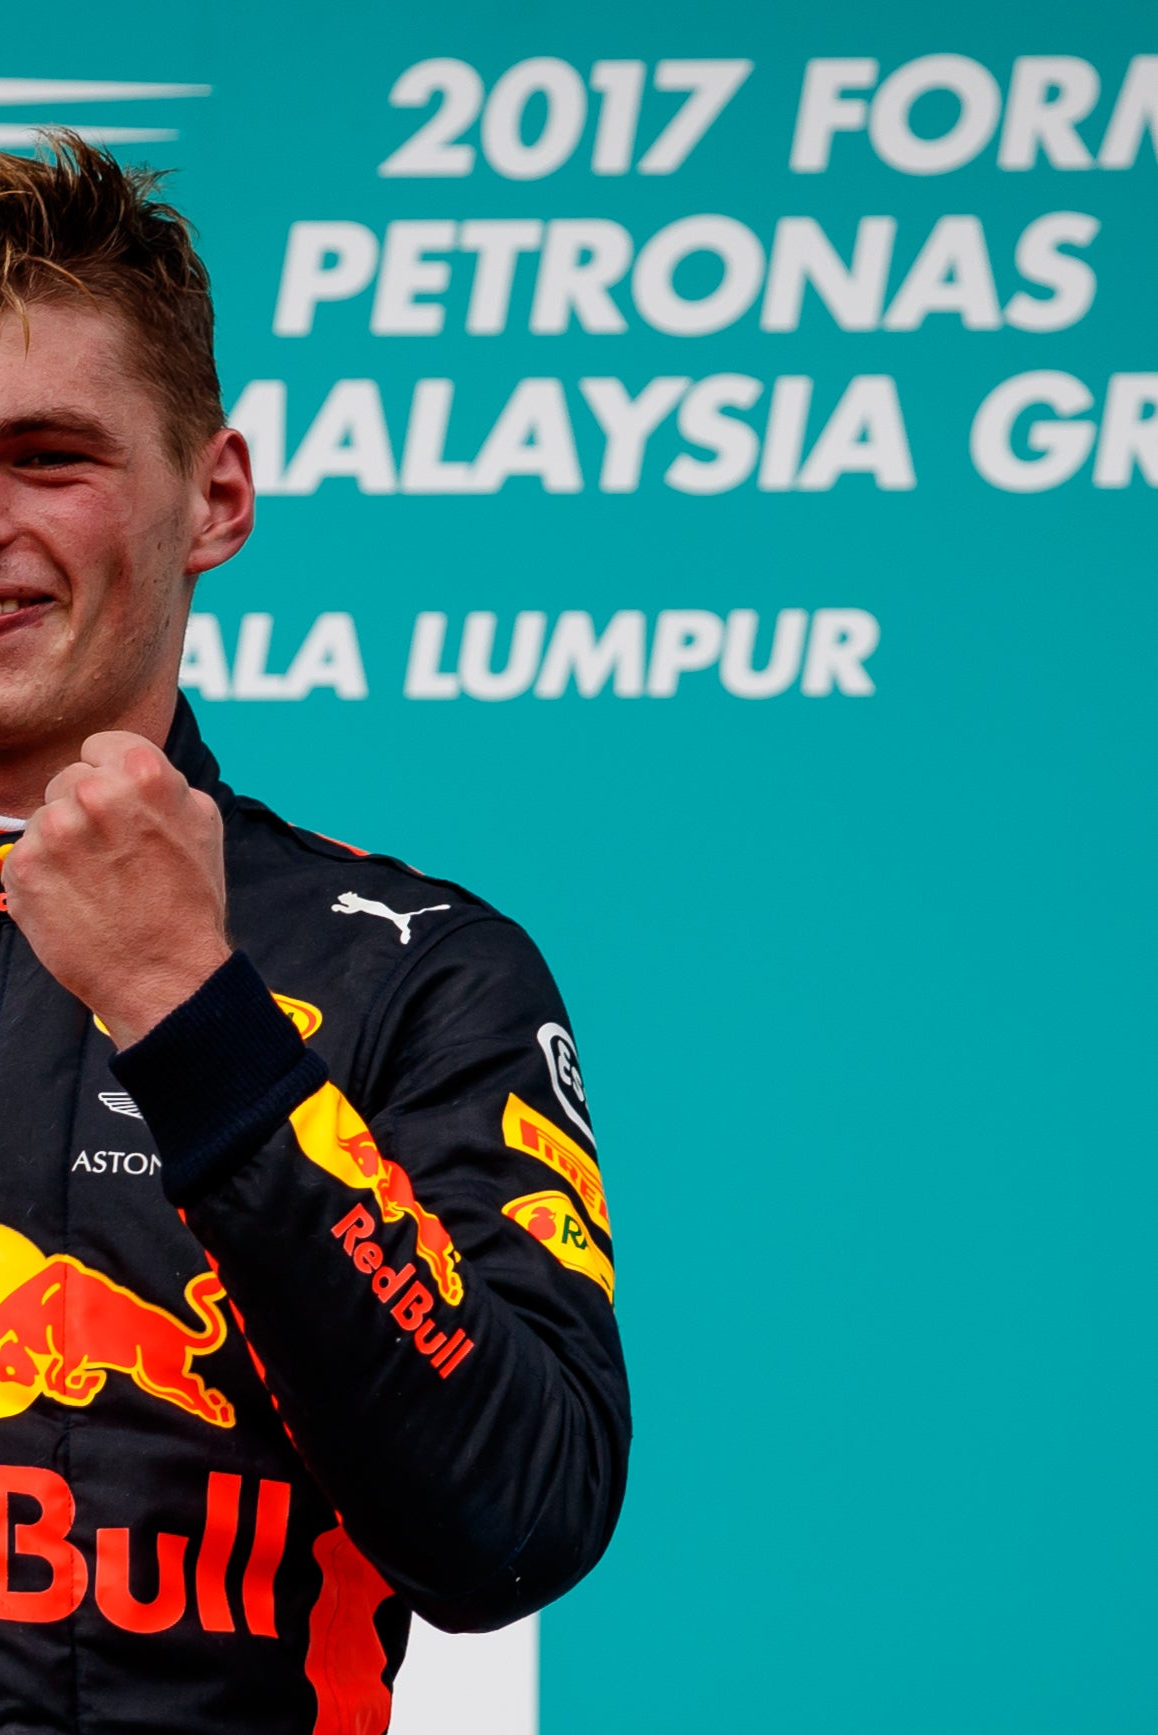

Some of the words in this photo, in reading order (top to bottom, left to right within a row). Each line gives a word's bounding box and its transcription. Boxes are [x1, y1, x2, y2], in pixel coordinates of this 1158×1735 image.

[379, 57, 753, 180] 2017
[273, 212, 1100, 337] PETRONAS
[404, 609, 881, 701] LUMPUR
[330, 1202, 417, 1304] Red
[389, 1279, 475, 1380] Bull
